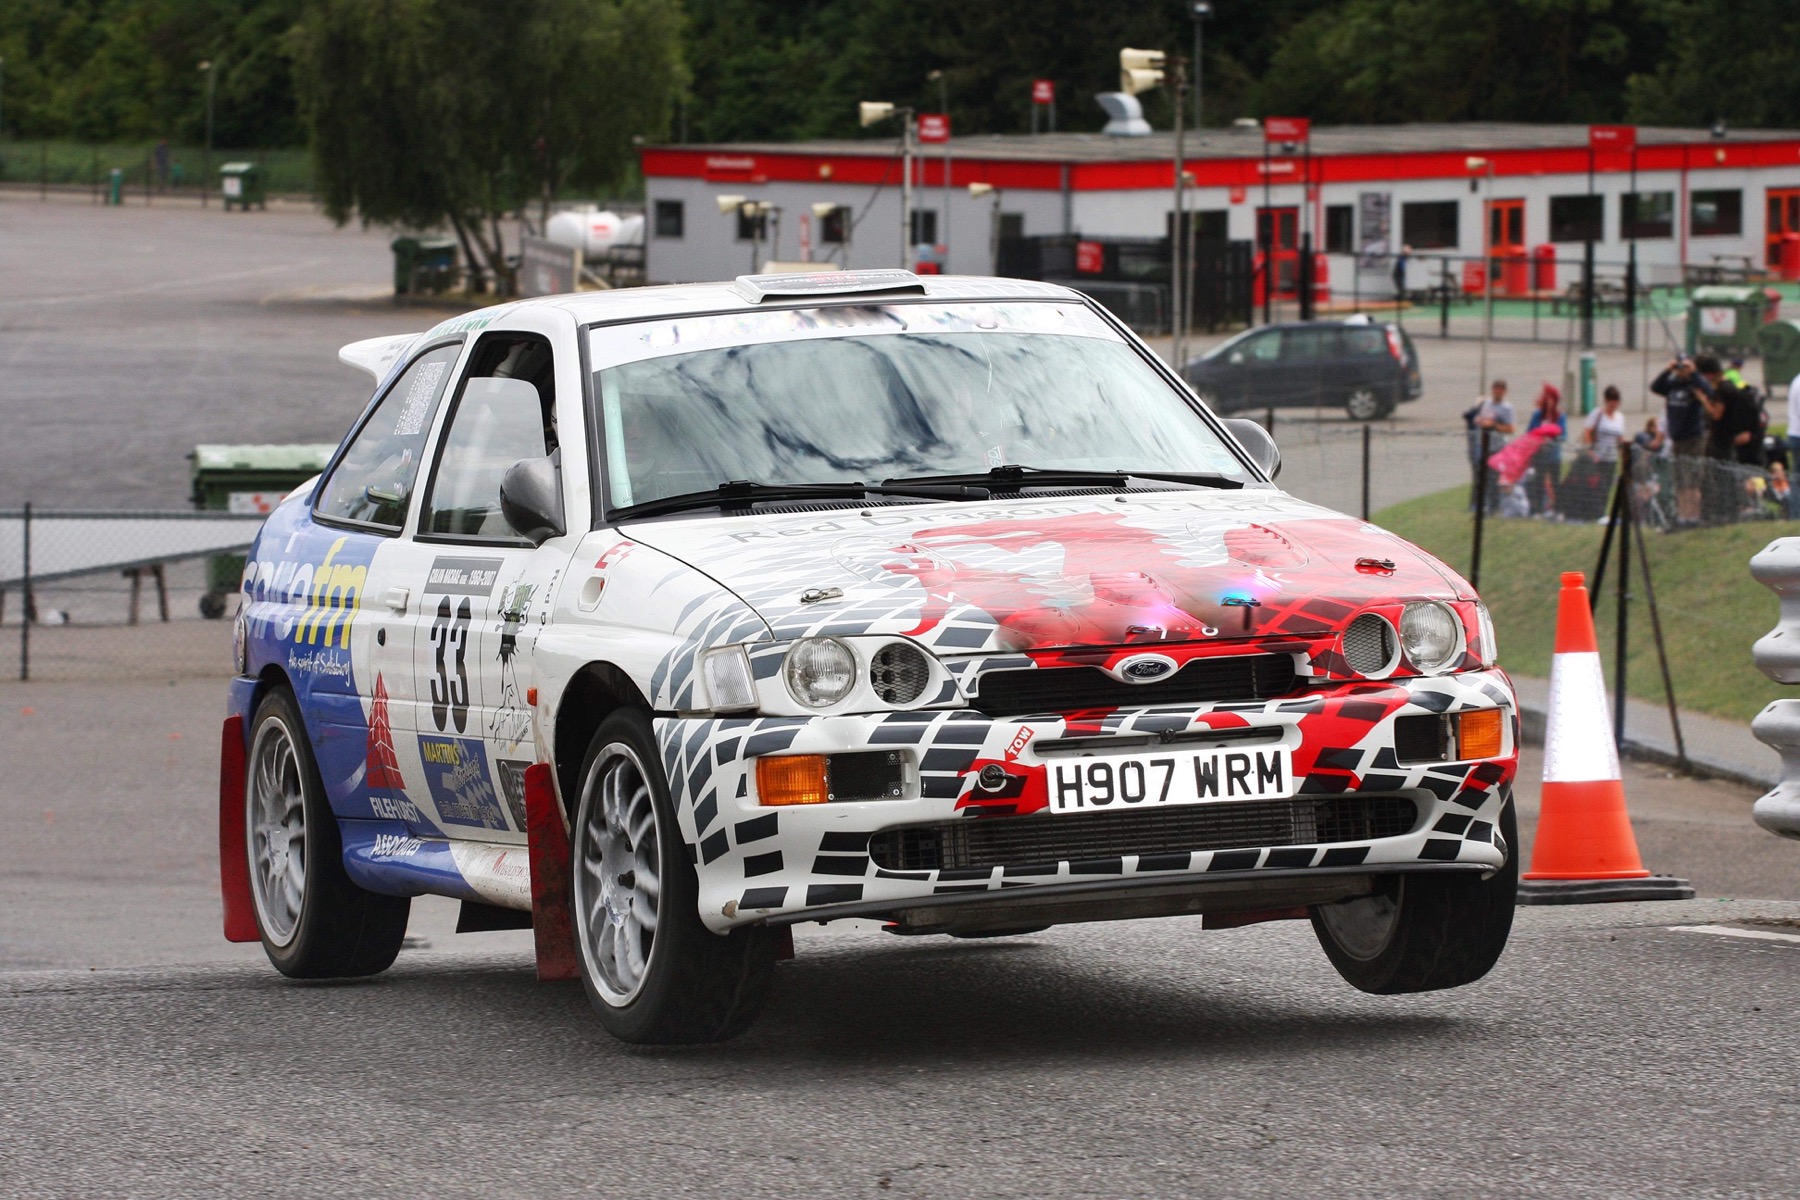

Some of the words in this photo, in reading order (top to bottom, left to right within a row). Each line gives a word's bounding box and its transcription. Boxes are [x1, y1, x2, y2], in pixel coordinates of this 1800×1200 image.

[729, 521, 846, 544] Red
[862, 505, 1078, 527] Dragon
[430, 595, 470, 734] 33
[1135, 662, 1161, 675] Ford
[422, 741, 461, 767] MARTINS
[1008, 726, 1031, 757] TOW
[1056, 758, 1176, 809] H907
[1193, 750, 1283, 799] WRM
[369, 796, 421, 823] FILEHURST
